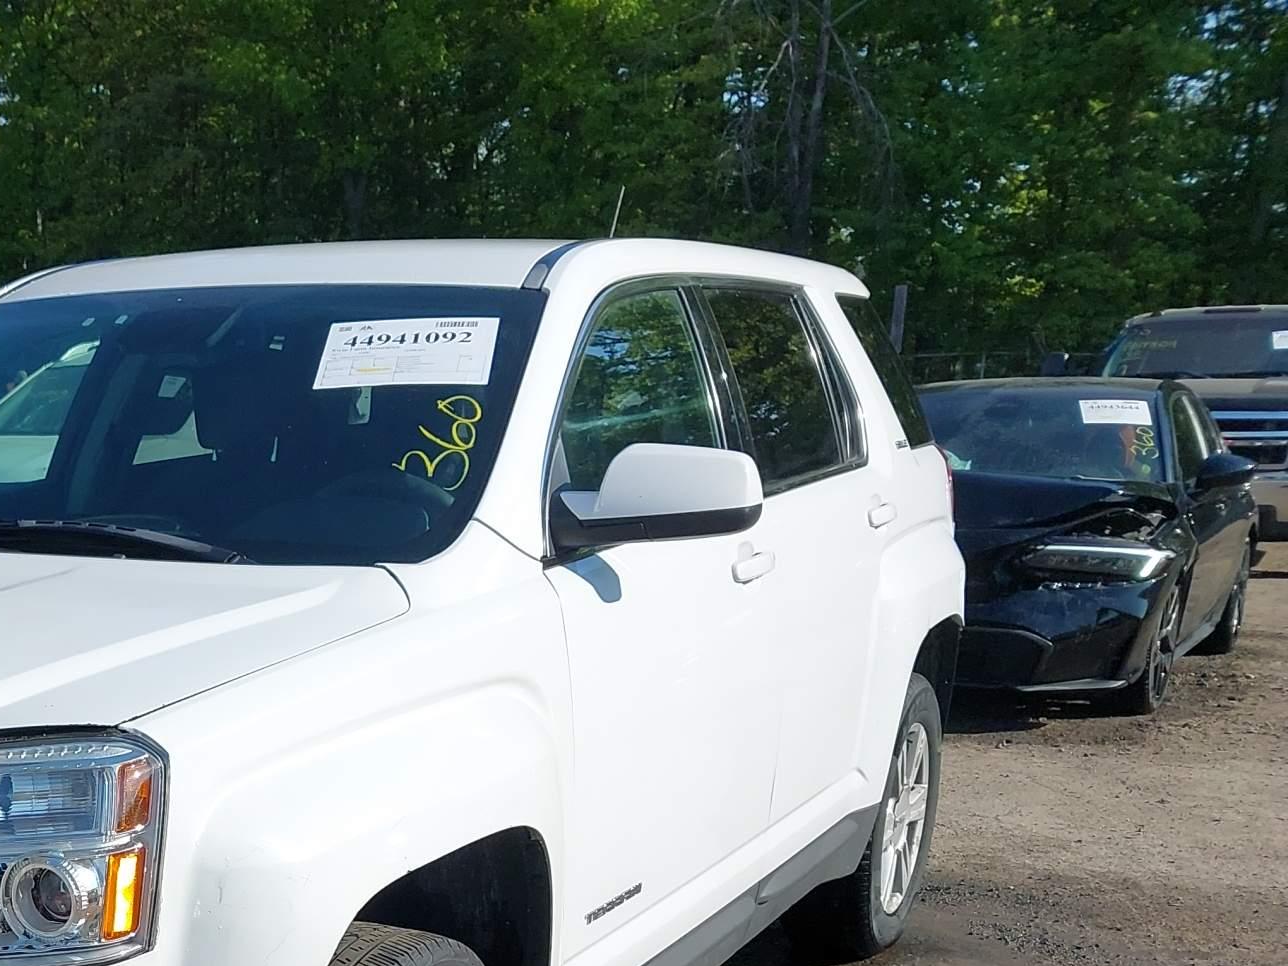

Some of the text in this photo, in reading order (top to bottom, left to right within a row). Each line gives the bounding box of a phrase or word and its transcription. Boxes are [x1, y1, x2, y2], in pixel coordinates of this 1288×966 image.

[344, 331, 473, 347] 44941092
[392, 395, 482, 490] 360
[1129, 426, 1160, 460] 360
